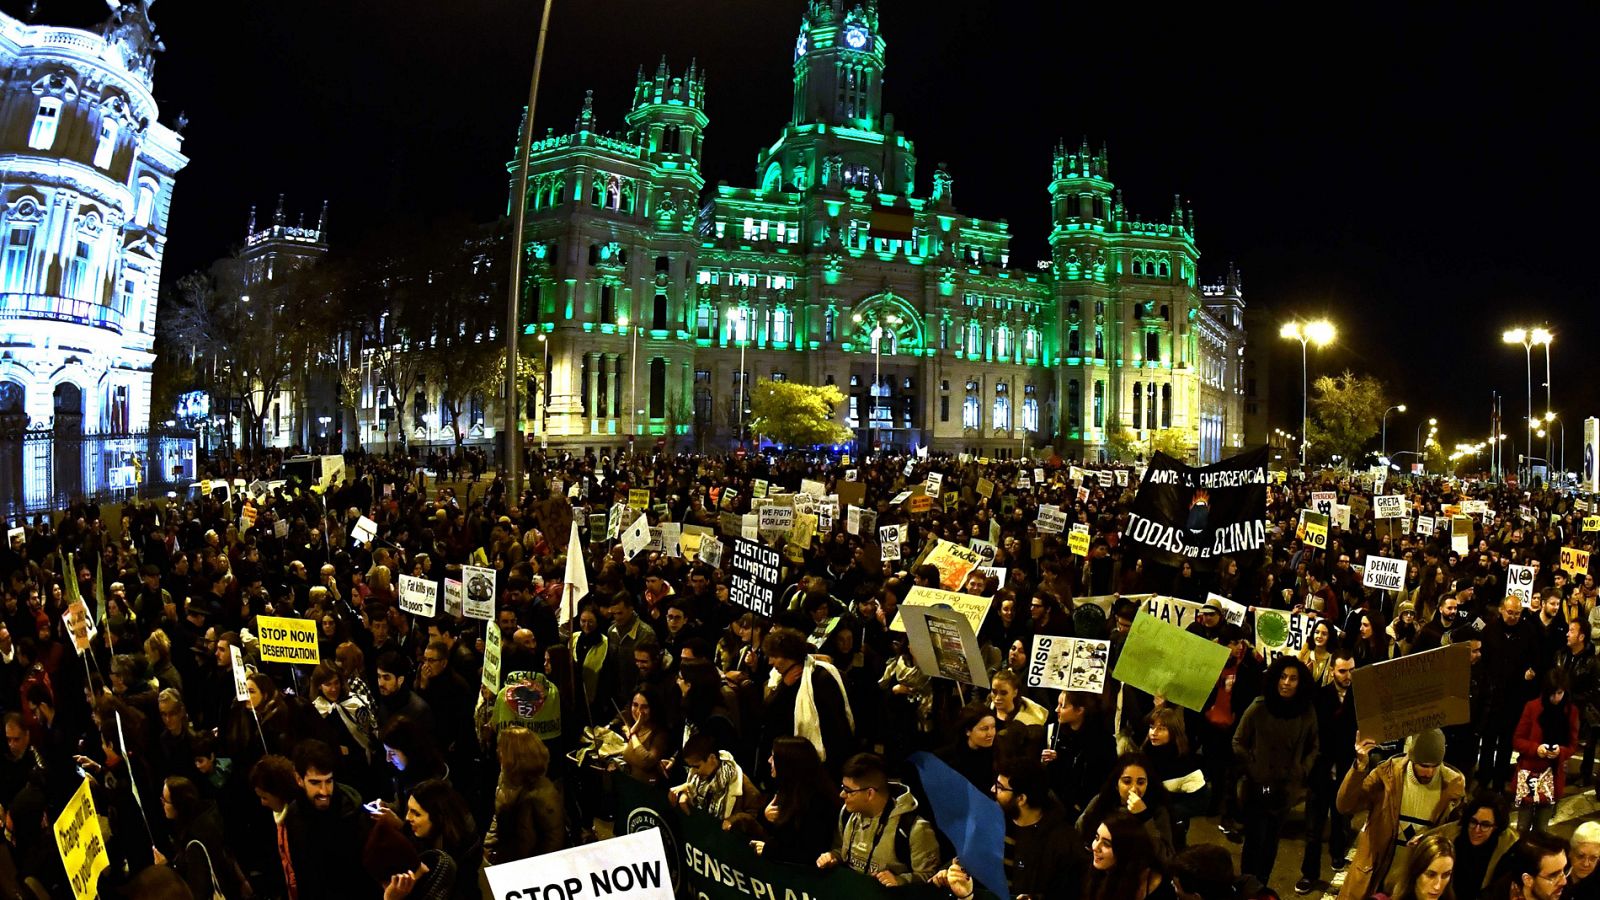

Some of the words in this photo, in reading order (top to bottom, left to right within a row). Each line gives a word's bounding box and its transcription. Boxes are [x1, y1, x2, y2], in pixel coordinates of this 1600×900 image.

[1150, 469, 1179, 485] ANTE
[1377, 497, 1400, 506] GRETA
[761, 508, 772, 516] WE
[773, 508, 792, 516] FIGTH
[1040, 512, 1053, 520] STOP
[1053, 515, 1065, 523] NOW
[761, 518, 774, 526] FOR
[774, 518, 791, 526] LIFE!
[1583, 519, 1599, 528] NO!
[1125, 512, 1184, 557] TODAS
[1183, 544, 1199, 558] POR
[1201, 547, 1211, 558] EL
[1213, 519, 1266, 555] CLIMA
[1304, 531, 1325, 545] NO
[733, 539, 780, 568] JUSTICIA
[732, 554, 778, 584] CLIMATICA
[1370, 560, 1399, 574] DENIAL
[1374, 572, 1401, 587] SUICIDE
[1509, 568, 1532, 585] NO
[407, 580, 415, 592] Fat
[415, 581, 426, 594] kills
[426, 586, 435, 597] you
[731, 575, 773, 604] JUSTICIA
[916, 589, 961, 602] NUESTRO
[408, 601, 423, 613] poors
[729, 587, 773, 618] SOCIAL!
[1148, 599, 1186, 627] HAY
[261, 627, 287, 641] STOP
[290, 630, 315, 643] NOW
[262, 643, 317, 660] DESERTIZATION!
[1029, 637, 1052, 686] CRISIS
[685, 841, 751, 895] SENSE
[591, 860, 663, 896] NOW
